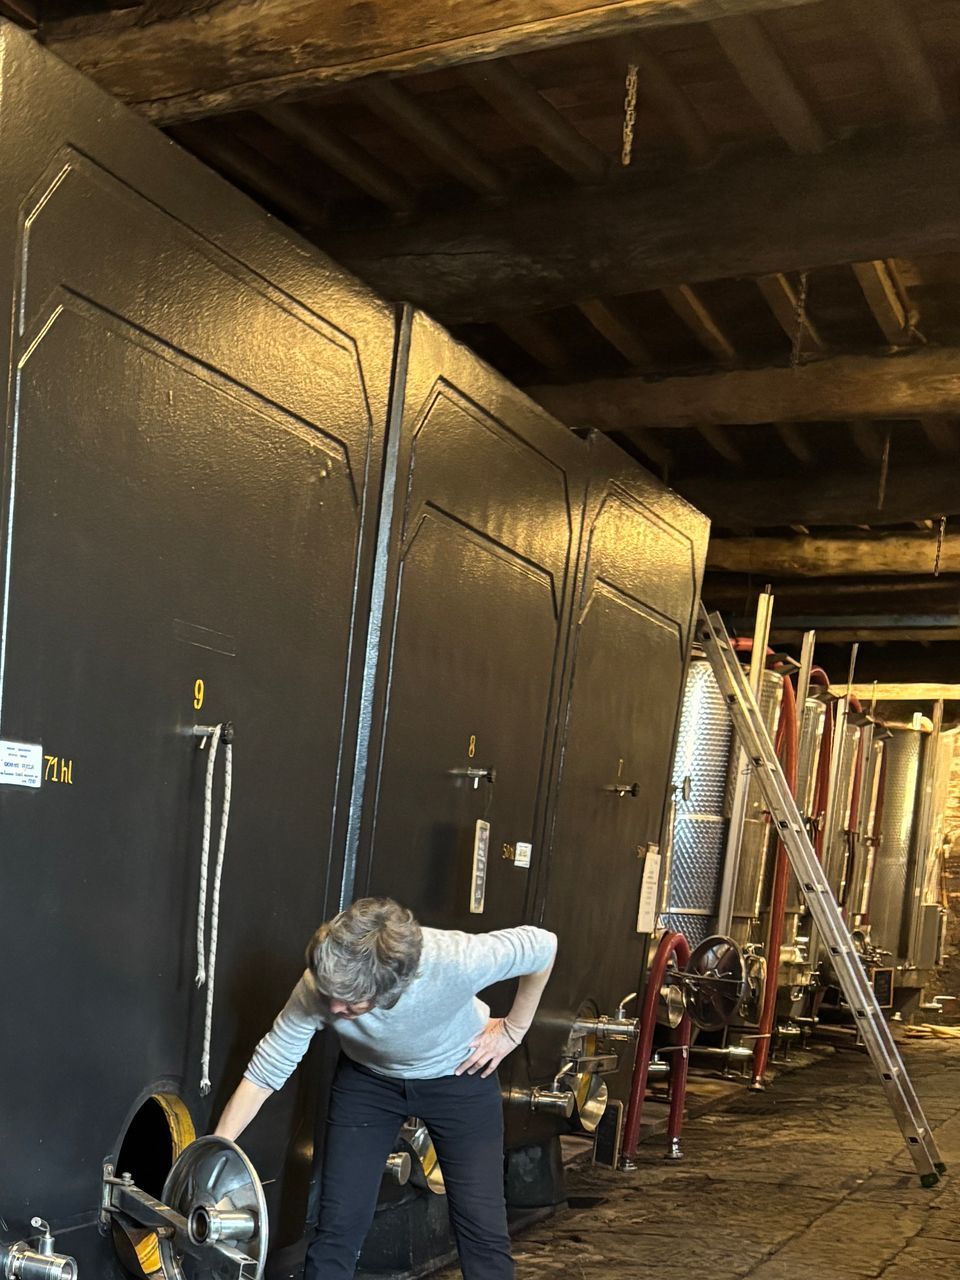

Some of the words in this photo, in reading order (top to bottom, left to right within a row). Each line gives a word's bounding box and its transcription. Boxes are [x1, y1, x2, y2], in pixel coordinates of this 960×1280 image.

[193, 678, 205, 710] 9
[468, 735, 476, 758] 8
[44, 755, 58, 782] 71
[60, 758, 73, 784] hl
